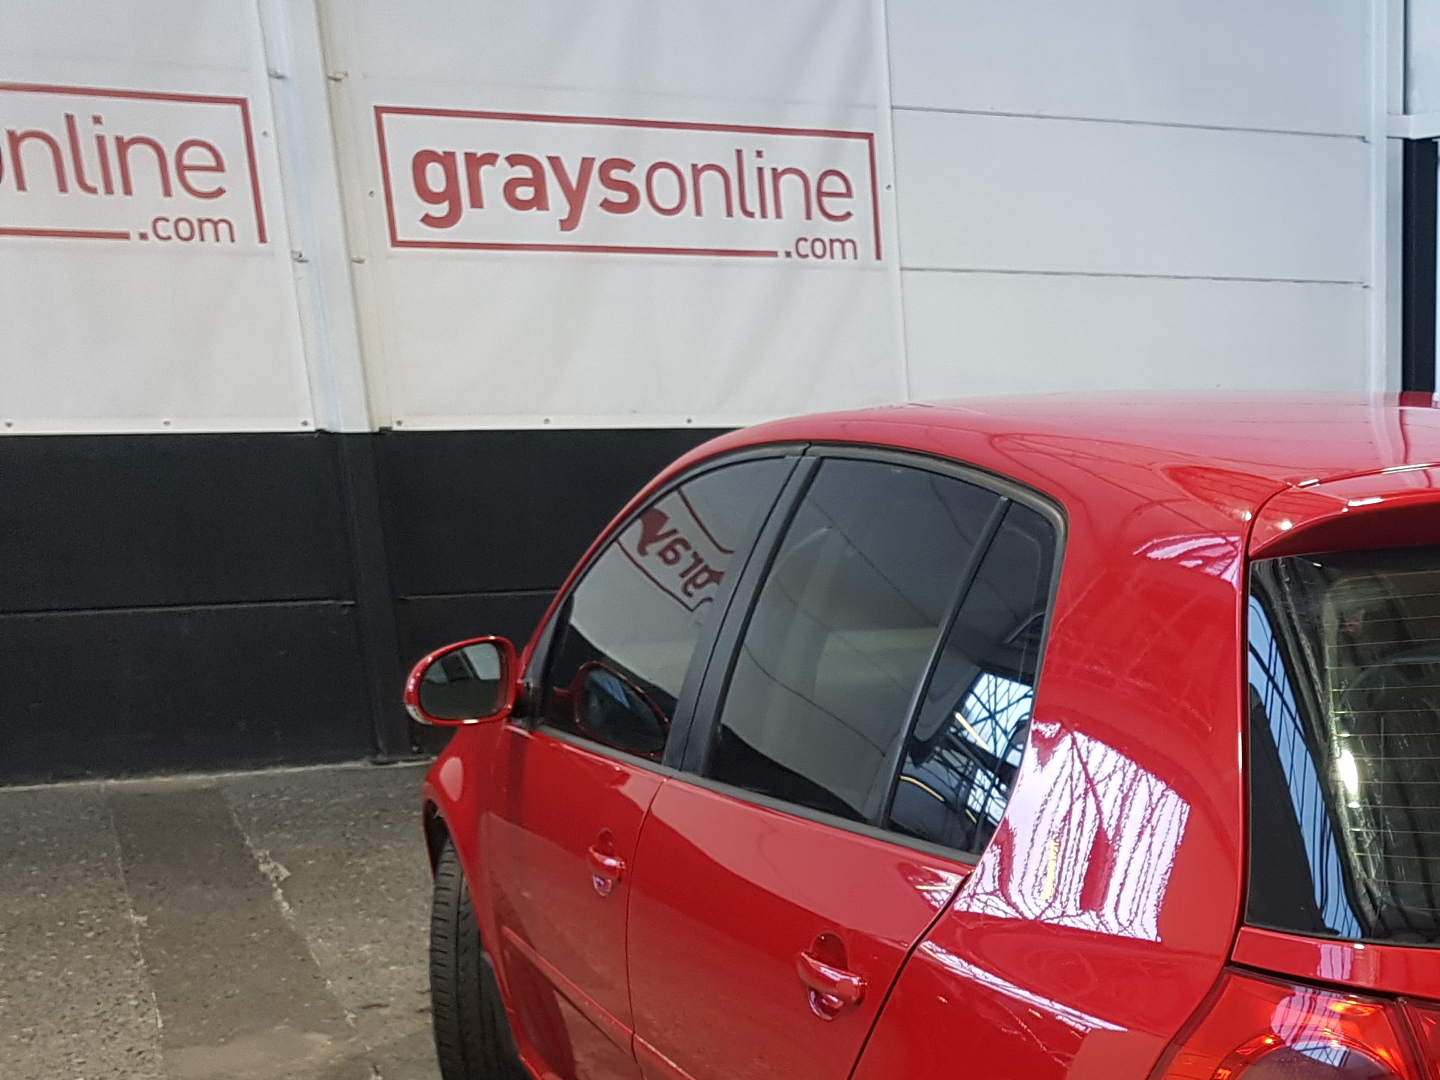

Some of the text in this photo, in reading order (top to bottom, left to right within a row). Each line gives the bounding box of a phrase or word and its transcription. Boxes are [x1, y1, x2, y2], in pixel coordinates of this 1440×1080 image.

[0, 113, 226, 200] nline
[411, 148, 855, 233] graysonline
[138, 216, 237, 243] .com
[784, 236, 859, 260] .com
